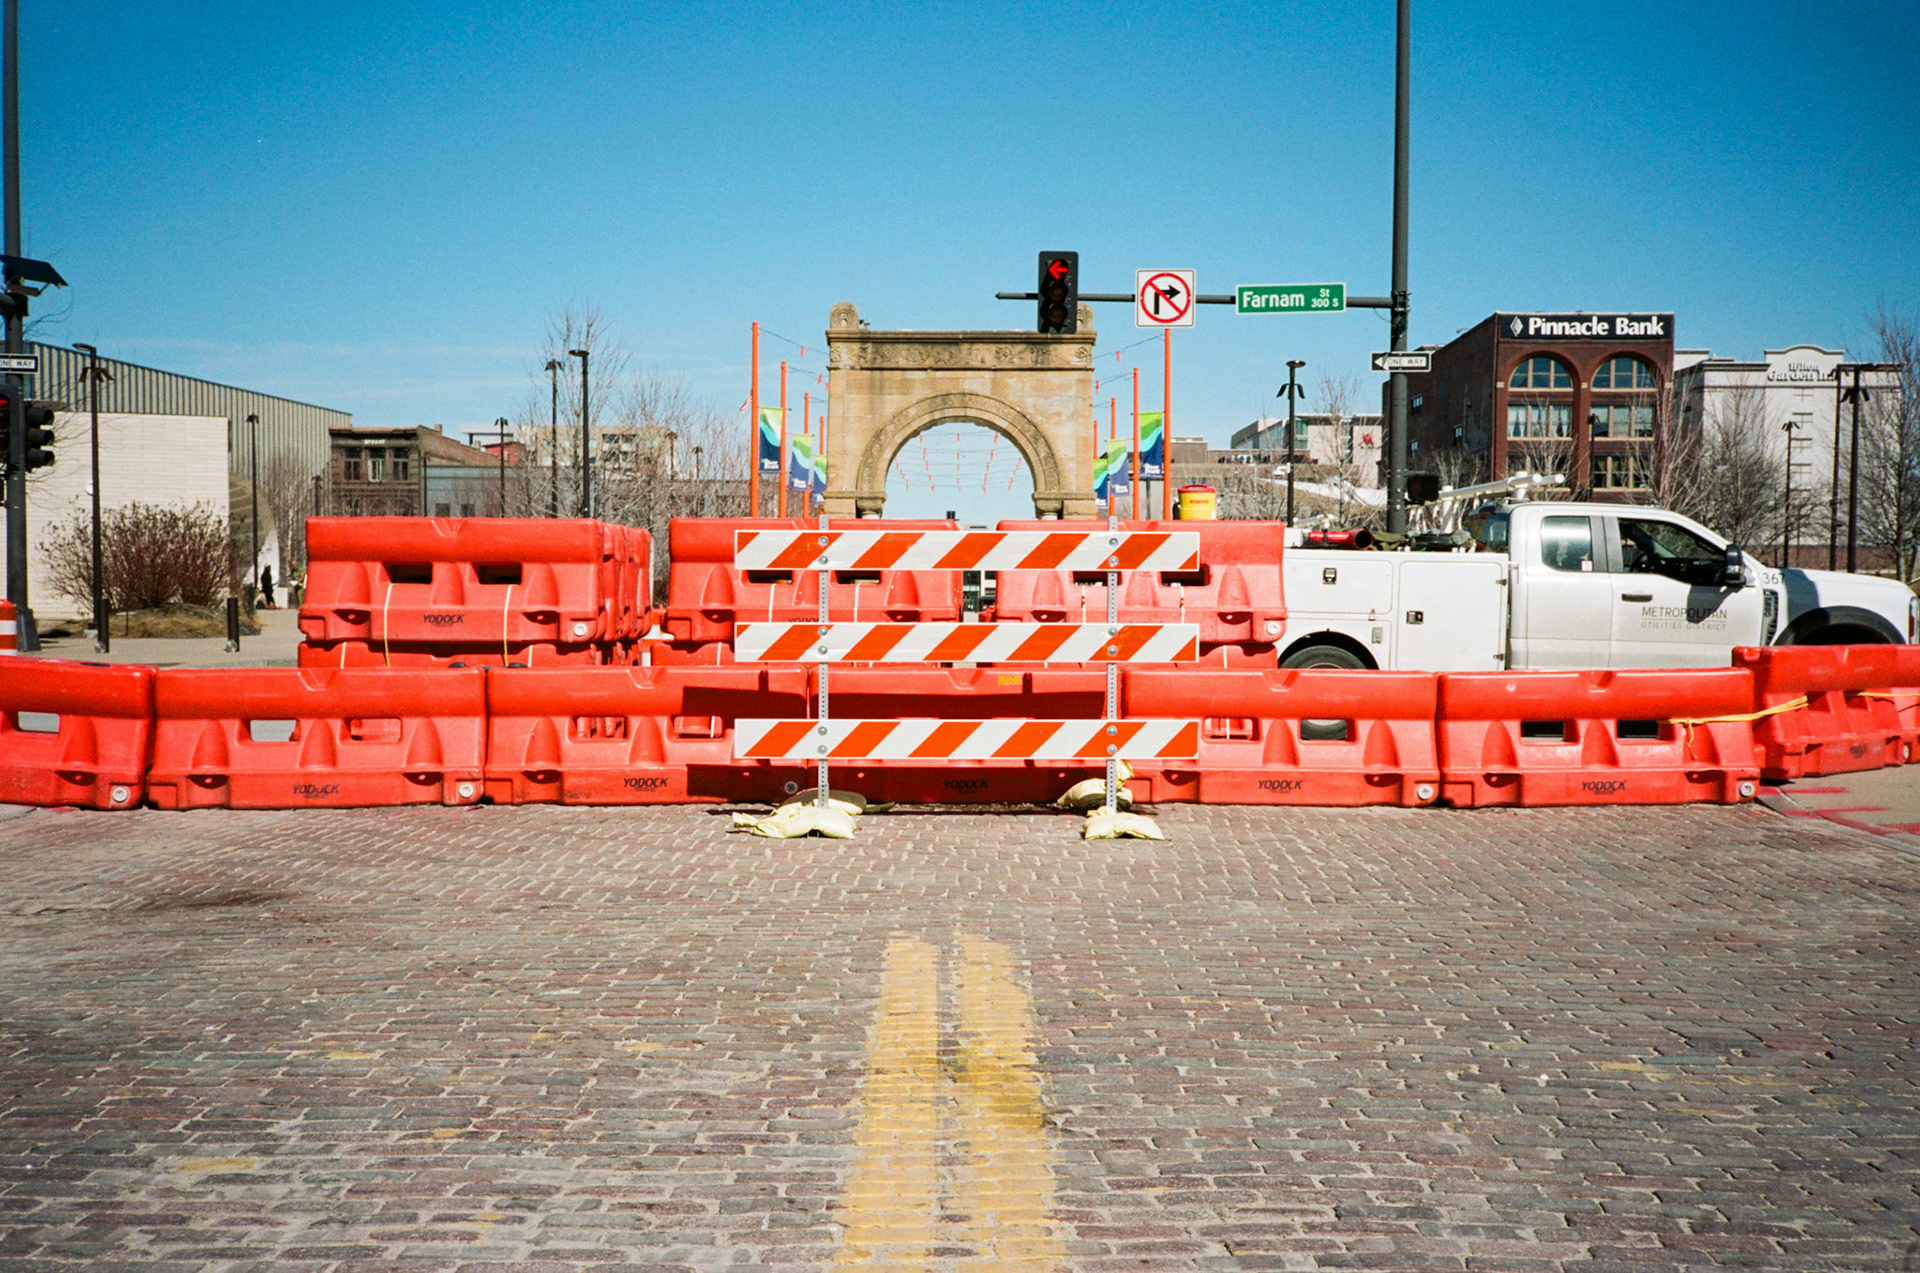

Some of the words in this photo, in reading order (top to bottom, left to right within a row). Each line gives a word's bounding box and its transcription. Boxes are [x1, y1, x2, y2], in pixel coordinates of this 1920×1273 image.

[1320, 288, 1330, 298] St
[1242, 291, 1305, 308] Farnam
[1311, 297, 1330, 308] 300
[1332, 298, 1339, 308] S
[1528, 316, 1609, 336] Pinnacle
[1615, 316, 1664, 336] Bank
[1387, 358, 1404, 366] ONE
[1407, 358, 1425, 366] WAY
[1767, 370, 1813, 382] Garden
[1641, 606, 1728, 620] METROPOLITAN
[423, 614, 465, 624] YODOCK
[1641, 621, 1681, 629] UTILITIES
[1686, 623, 1727, 631] DISTRICT
[624, 777, 668, 788] YODOCK
[945, 779, 988, 790] YODOCK
[1258, 779, 1303, 790] YODOCK
[1582, 779, 1627, 790] YODOCK
